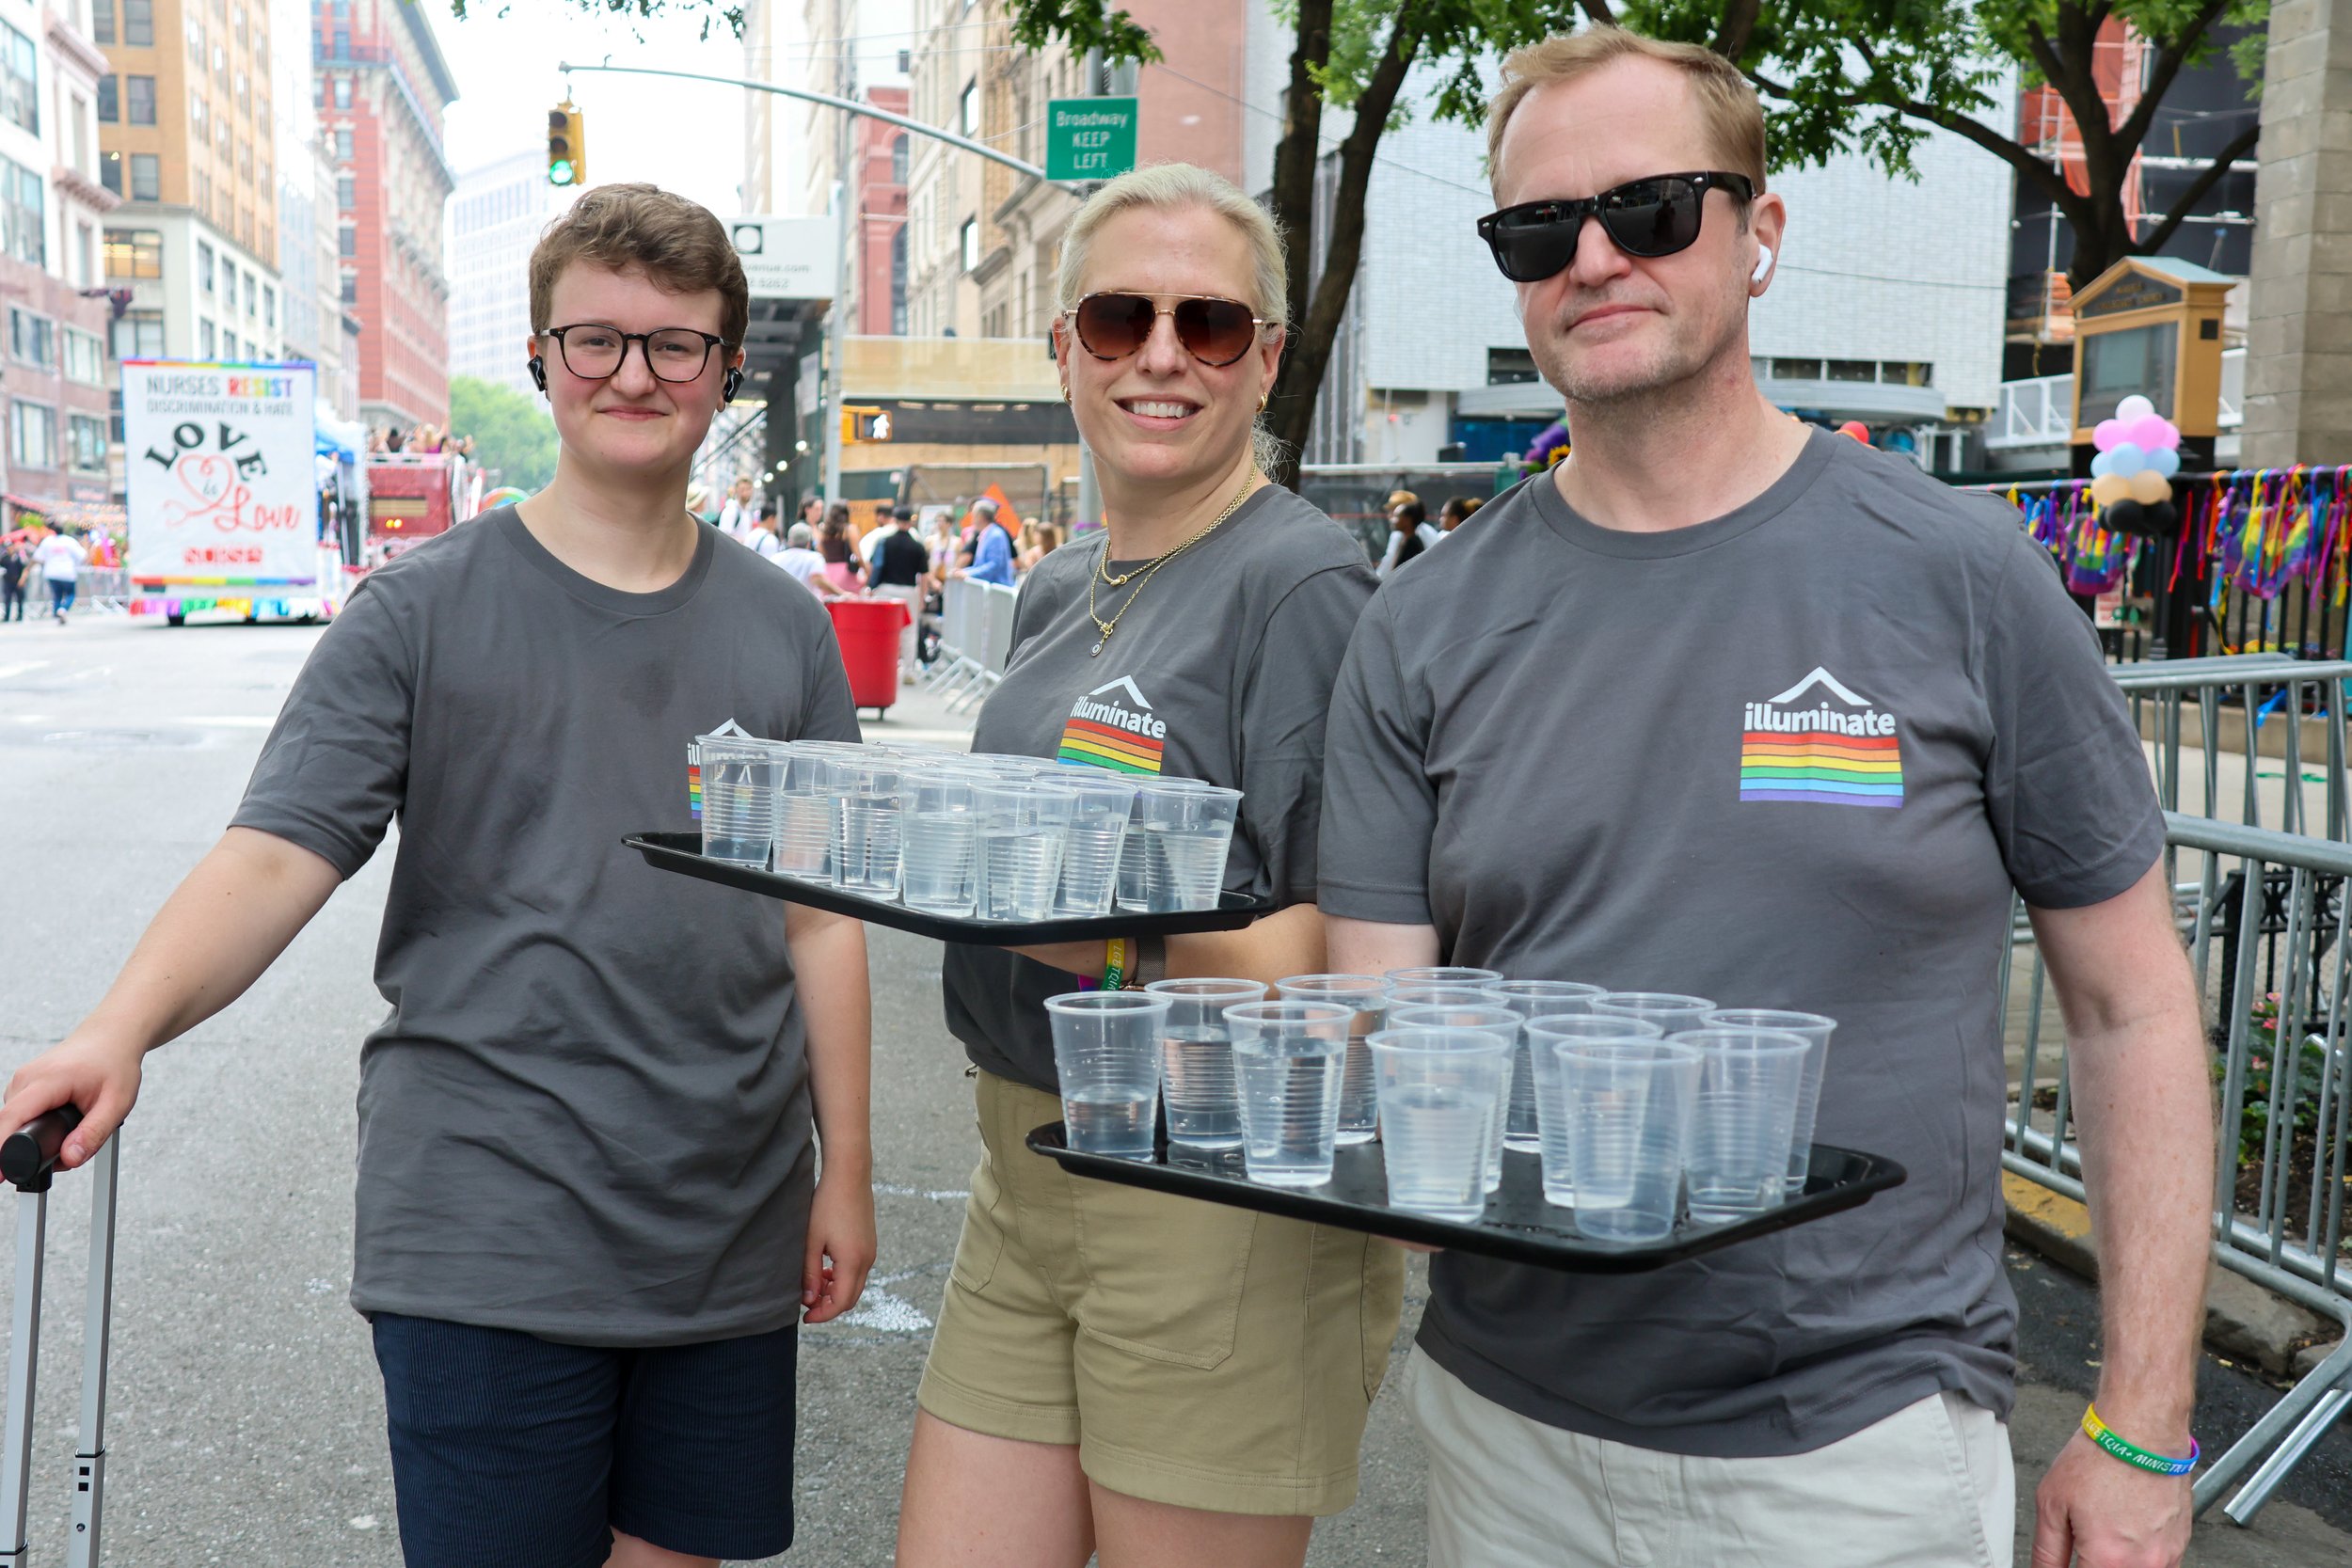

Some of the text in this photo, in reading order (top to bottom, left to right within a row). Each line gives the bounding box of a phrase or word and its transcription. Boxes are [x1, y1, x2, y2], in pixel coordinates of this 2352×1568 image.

[1057, 110, 1128, 129] Broadway
[1073, 131, 1110, 147] KEEP
[1073, 152, 1108, 168] LEFT
[742, 264, 810, 274] venue.com
[146, 375, 294, 397] NURSES RESIST
[144, 421, 268, 483] LOVE
[214, 483, 301, 532] Love
[1070, 695, 1167, 738] illuminate
[1744, 702, 1896, 736] illuminate
[2133, 1453, 2187, 1473] MINISTRY
